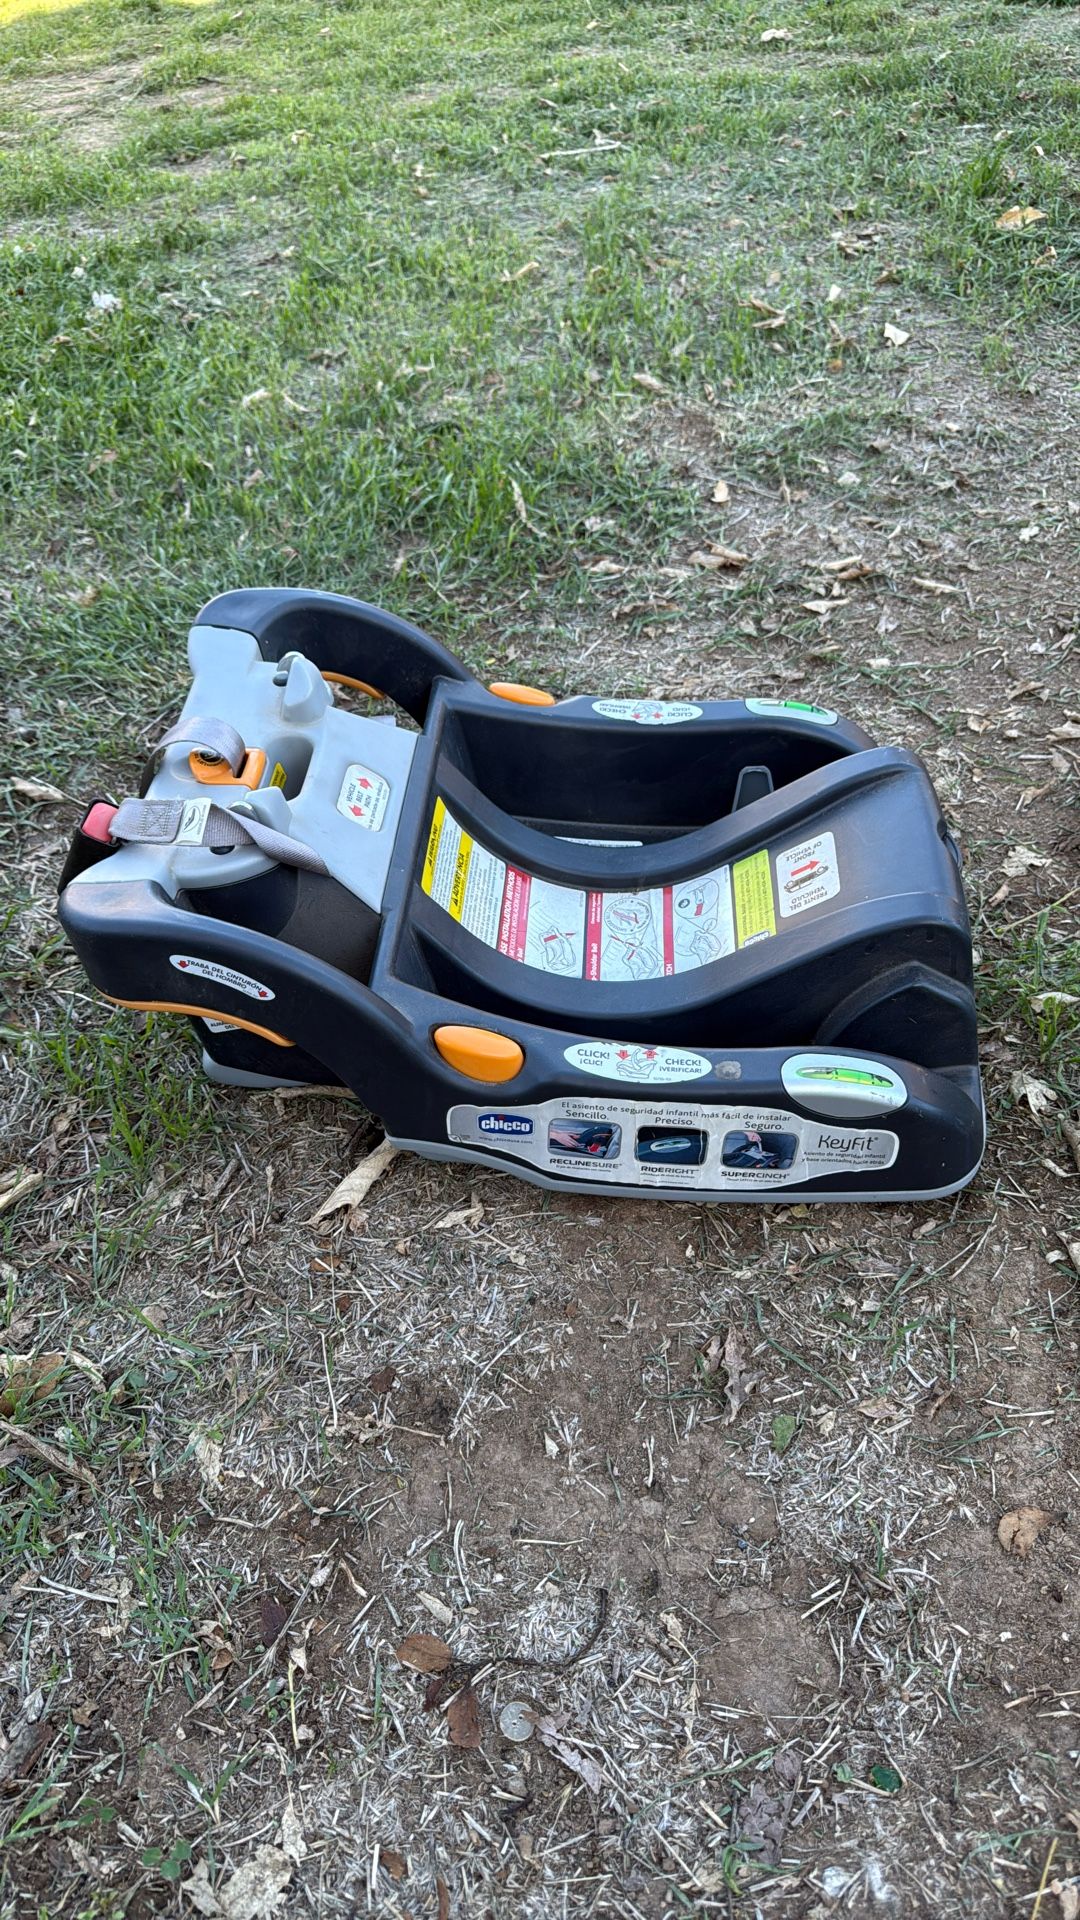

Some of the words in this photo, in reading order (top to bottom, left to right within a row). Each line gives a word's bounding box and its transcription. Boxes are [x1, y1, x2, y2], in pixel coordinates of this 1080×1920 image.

[786, 846, 811, 861] VEHICLE
[794, 850, 815, 863] FRONT
[507, 870, 515, 899] METHODS
[804, 891, 828, 905] FRENTE
[502, 899, 512, 940] INSTALLATION
[500, 941, 509, 954] ASE
[187, 960, 210, 970] TRABA
[211, 966, 224, 974] DEL
[202, 969, 214, 977] DEL
[216, 974, 247, 989] HOMBRO
[577, 1048, 610, 1060] CLICK!
[580, 1058, 603, 1067] ¡CLIC!
[665, 1058, 701, 1066] CHECK!
[659, 1066, 702, 1074] ¡VERIFICAR!
[561, 1101, 570, 1109] El
[572, 1103, 604, 1111] asiento
[607, 1104, 618, 1112] de
[621, 1106, 664, 1115] seguridad
[666, 1109, 699, 1117] infantil
[722, 1112, 742, 1120] fácil
[756, 1114, 792, 1122] instalar
[565, 1109, 609, 1120] Sencillo.
[481, 1113, 531, 1132] chicco
[655, 1116, 696, 1126] Preciso.
[744, 1121, 784, 1131] Seguro.
